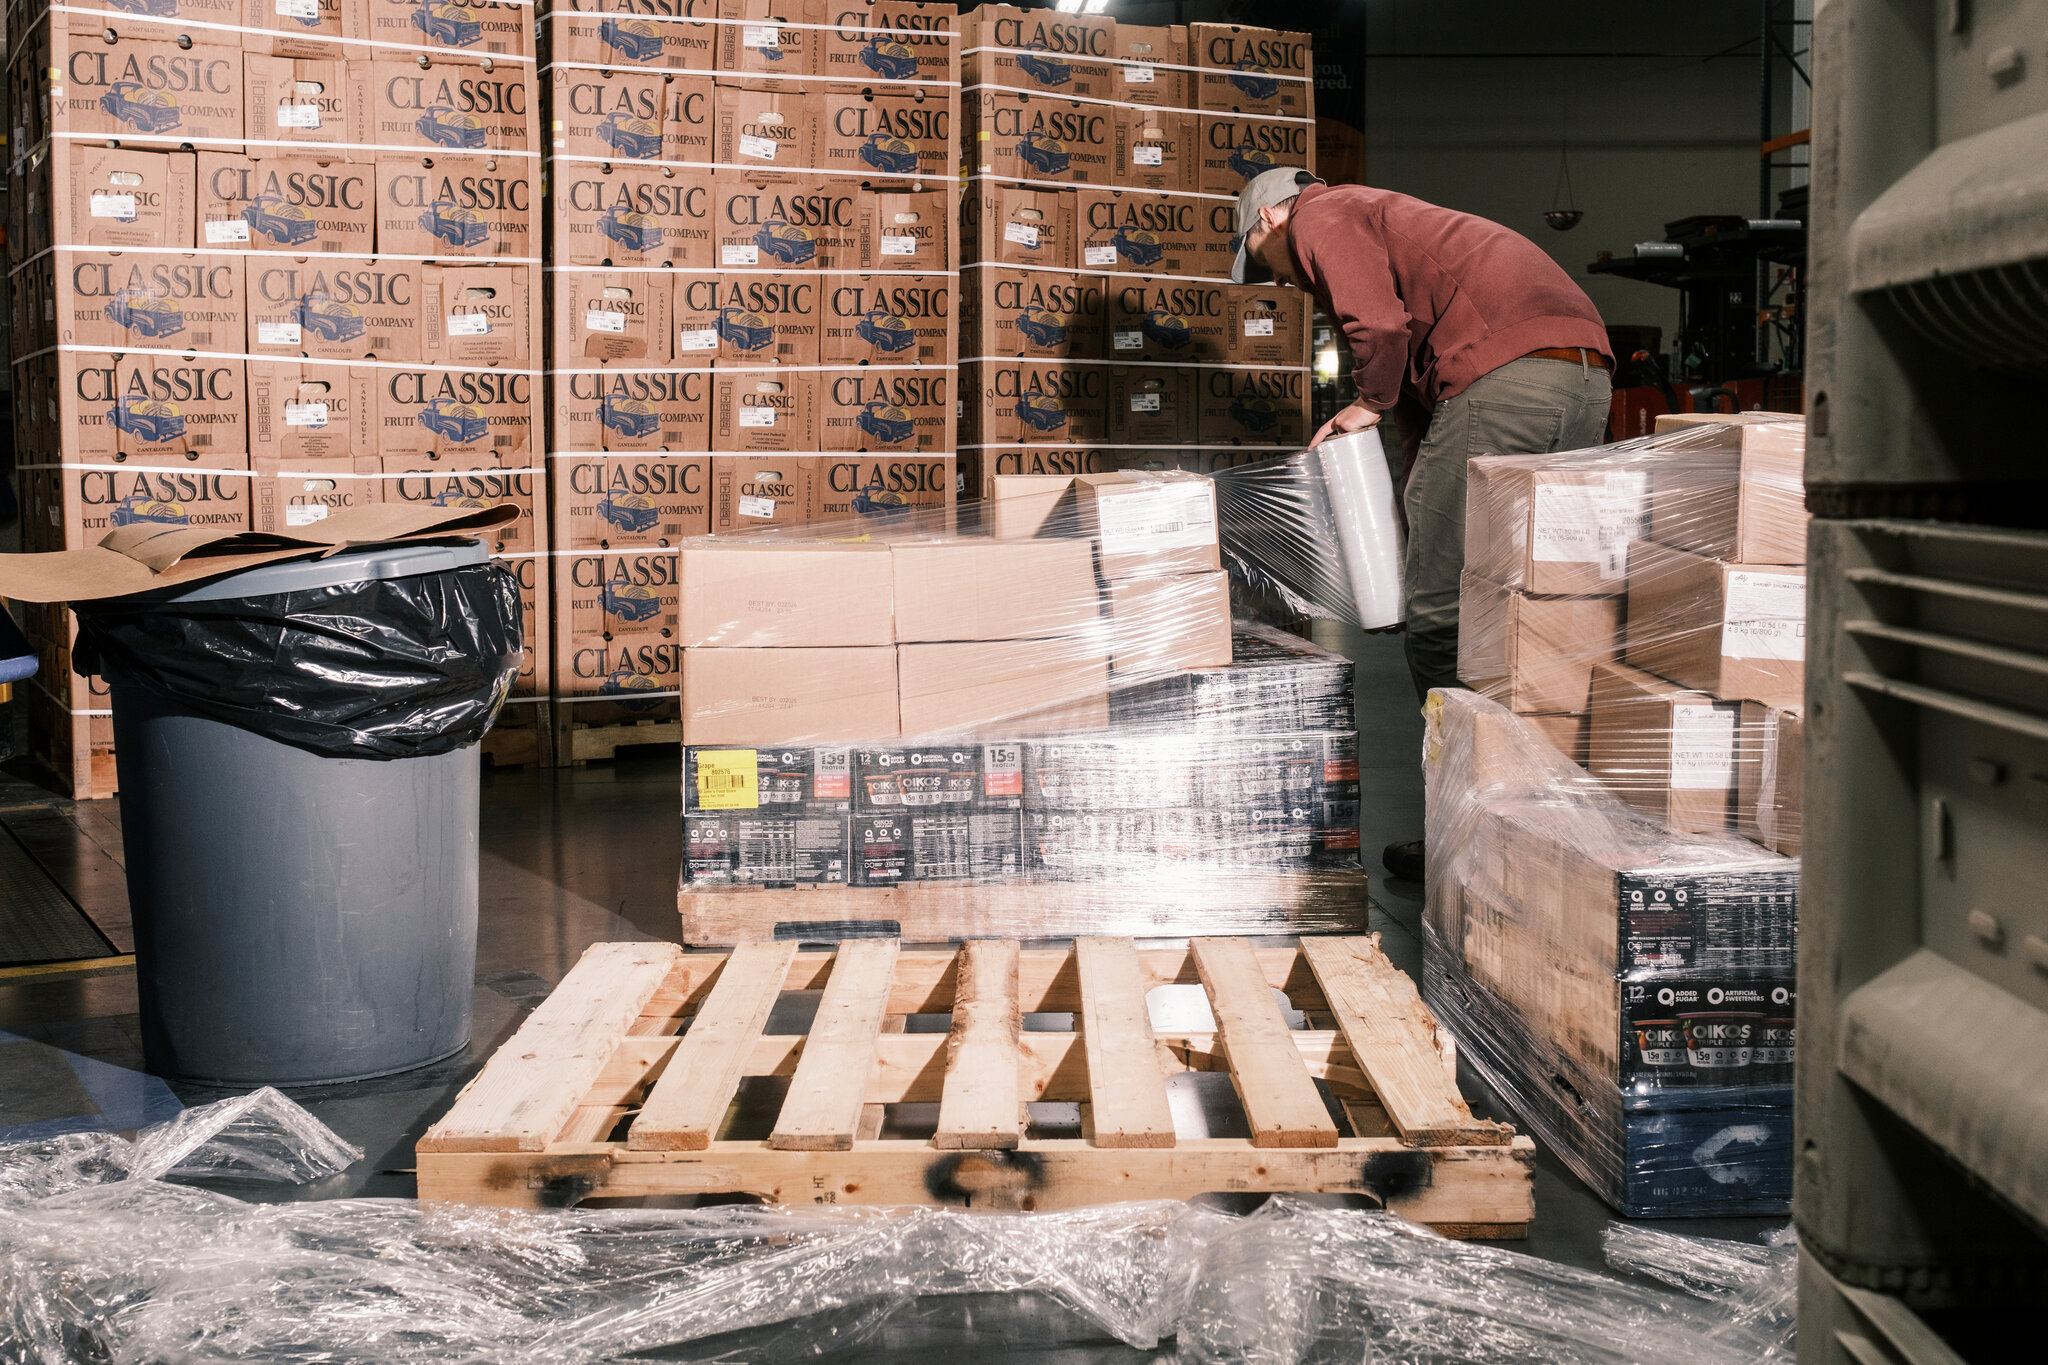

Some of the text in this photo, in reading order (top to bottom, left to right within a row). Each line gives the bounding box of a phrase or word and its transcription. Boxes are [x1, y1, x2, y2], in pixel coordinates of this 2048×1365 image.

[377, 18, 408, 28] FRUIT
[481, 21, 522, 32] COMPAN
[835, 12, 949, 45] CLASSIC
[664, 36, 709, 49] COMPANY
[994, 18, 1107, 56] CLASSIC
[829, 54, 856, 63] FRUIT
[1209, 37, 1305, 70] CLASSIC
[918, 56, 949, 65] COMPAN
[995, 57, 1013, 67] RUIT
[69, 51, 231, 93] CLASSIC
[1071, 65, 1109, 77] COMPANY
[1204, 75, 1226, 83] FRUIT
[386, 76, 525, 115] CLASSIC
[69, 99, 96, 110] RUIT
[180, 106, 236, 118] COMPANY
[381, 122, 412, 132] FRUIT
[834, 106, 948, 140] CLASSIC
[994, 108, 1104, 144] CLASSIC
[486, 126, 526, 137] COMPAN
[570, 126, 593, 136] RUIT
[743, 124, 796, 140] CLASSIC
[662, 134, 707, 145] COMPANY
[1209, 122, 1306, 154] CLASSIC
[829, 148, 856, 158] FRUIT
[918, 150, 948, 160] COMPAN
[994, 148, 1013, 156] RUIT
[1070, 153, 1107, 164] COMPANY
[1205, 160, 1226, 168] FRUIT
[210, 166, 363, 210] CLASSIC
[388, 175, 529, 211] CLASSIC
[569, 180, 706, 218] CLASSIC
[726, 194, 852, 227] CLASSIC
[1088, 202, 1194, 233] CLASSIC
[316, 220, 367, 234] COMPANY
[385, 220, 416, 231] FRUIT
[489, 222, 529, 233] COMPAN
[570, 223, 594, 233] RUIT
[663, 228, 709, 239] COMPANY
[815, 238, 856, 248] COMPANY
[1162, 242, 1197, 251] COMPANY
[1206, 243, 1227, 252] FRUIT
[73, 263, 232, 299] CLASSIC
[259, 268, 410, 305] CLASSIC
[686, 280, 811, 314] CLASSIC
[831, 287, 948, 317] CLASSIC
[995, 281, 1099, 315] CLASSIC
[1120, 287, 1221, 316] CLASSIC
[74, 310, 101, 320] RUIT
[184, 311, 238, 322] COMPANY
[365, 316, 414, 328] COMPANY
[773, 324, 815, 335] COMPANY
[827, 328, 853, 337] FRUIT
[915, 329, 947, 337] COMPAN
[1190, 327, 1223, 335] COMPANY
[77, 368, 232, 401] CLASSIC
[389, 372, 529, 404] CLASSIC
[570, 372, 700, 401] CLASSIC
[995, 370, 1100, 398] CLASSIC
[1210, 371, 1302, 400] CLASSIC
[832, 377, 946, 407] CLASSIC
[742, 394, 794, 408] CLASSIC
[79, 415, 104, 425] RUIT
[185, 414, 237, 424] COMPANY
[385, 417, 415, 426] FRUIT
[570, 412, 593, 422] RUIT
[659, 412, 704, 422] COMPANY
[826, 418, 853, 427] FRUIT
[914, 417, 945, 426] COMPAN
[996, 451, 1101, 474] CLASSIC
[397, 466, 532, 500] CLASSIC
[570, 464, 700, 495] CLASSIC
[828, 463, 945, 492] CLASSIC
[81, 468, 237, 504] CLASSIC
[742, 484, 794, 497] CLASSIC
[291, 494, 353, 508] CLASSIC
[570, 506, 594, 516] RUIT
[659, 505, 704, 515] COMPANY
[824, 504, 849, 512] FRUIT
[83, 518, 108, 528] RUIT
[190, 513, 242, 524] COMPANY
[572, 556, 678, 588] CLASSI
[572, 600, 595, 609] RUIT
[860, 754, 870, 762] 12
[990, 749, 1014, 762] 15g
[903, 777, 941, 786] OIKOS
[1629, 986, 1645, 997] 12
[1692, 1024, 1751, 1039] OIKOS
[1648, 1051, 1660, 1059] 15g
[1695, 1051, 1710, 1061] 15g
[813, 1176, 824, 1188] HT
